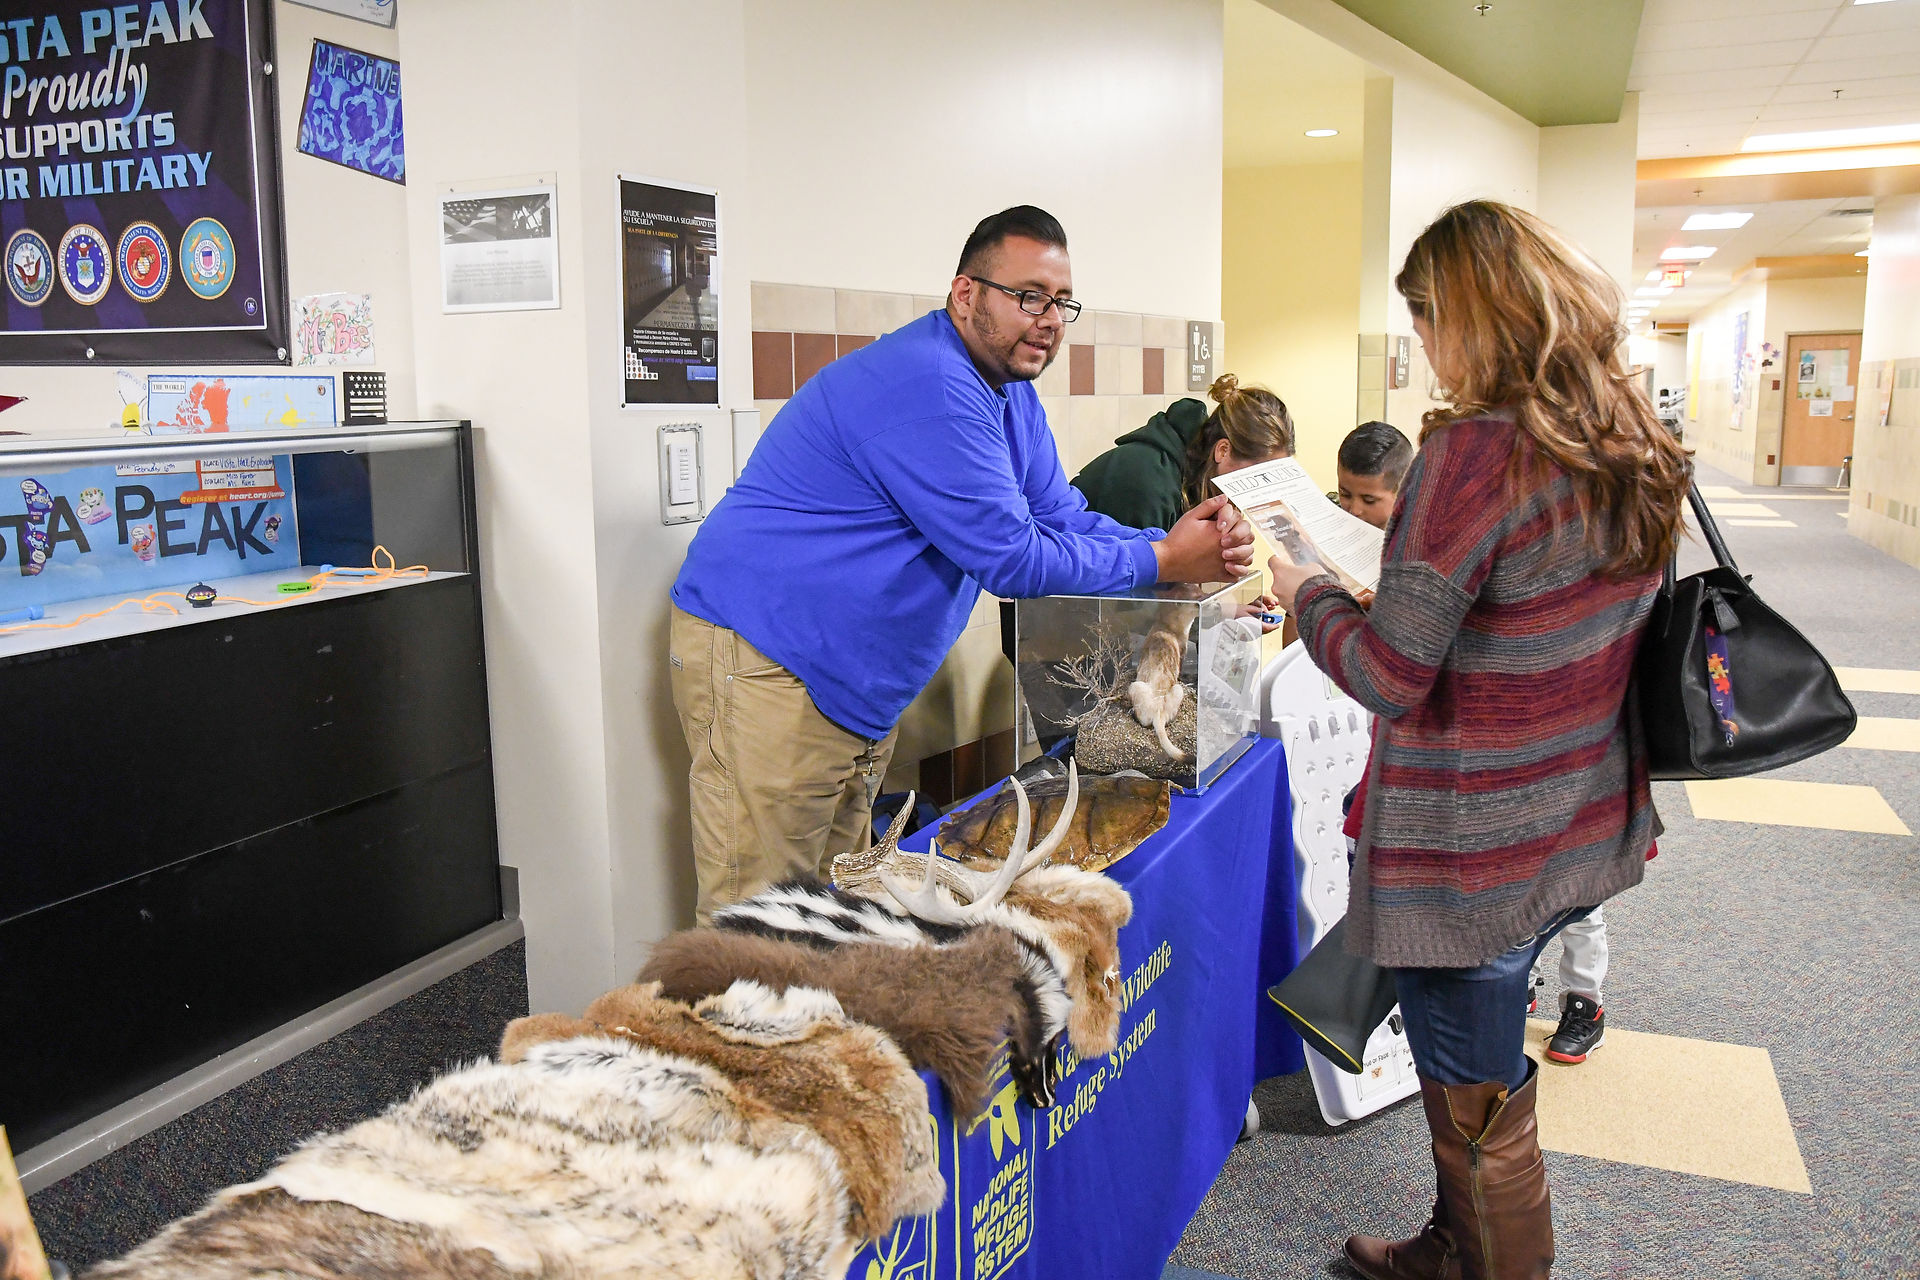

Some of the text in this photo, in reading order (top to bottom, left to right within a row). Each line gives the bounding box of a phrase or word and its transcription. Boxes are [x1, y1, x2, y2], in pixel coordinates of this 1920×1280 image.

[80, 0, 214, 54] PEAK
[3, 45, 148, 119] Proudly
[0, 112, 175, 160] UPPORTS
[0, 152, 212, 200] R MILITARY
[622, 209, 640, 217] AYUDE
[646, 211, 673, 222] MANTENER
[680, 217, 707, 227] SEGURIDAD
[631, 217, 654, 226] ESCUELA
[332, 312, 371, 354] Bee
[164, 383, 185, 391] WORLD
[115, 484, 274, 560] PEAK
[1121, 940, 1173, 1014] Wildlife
[1046, 1008, 1157, 1150] Refuge System
